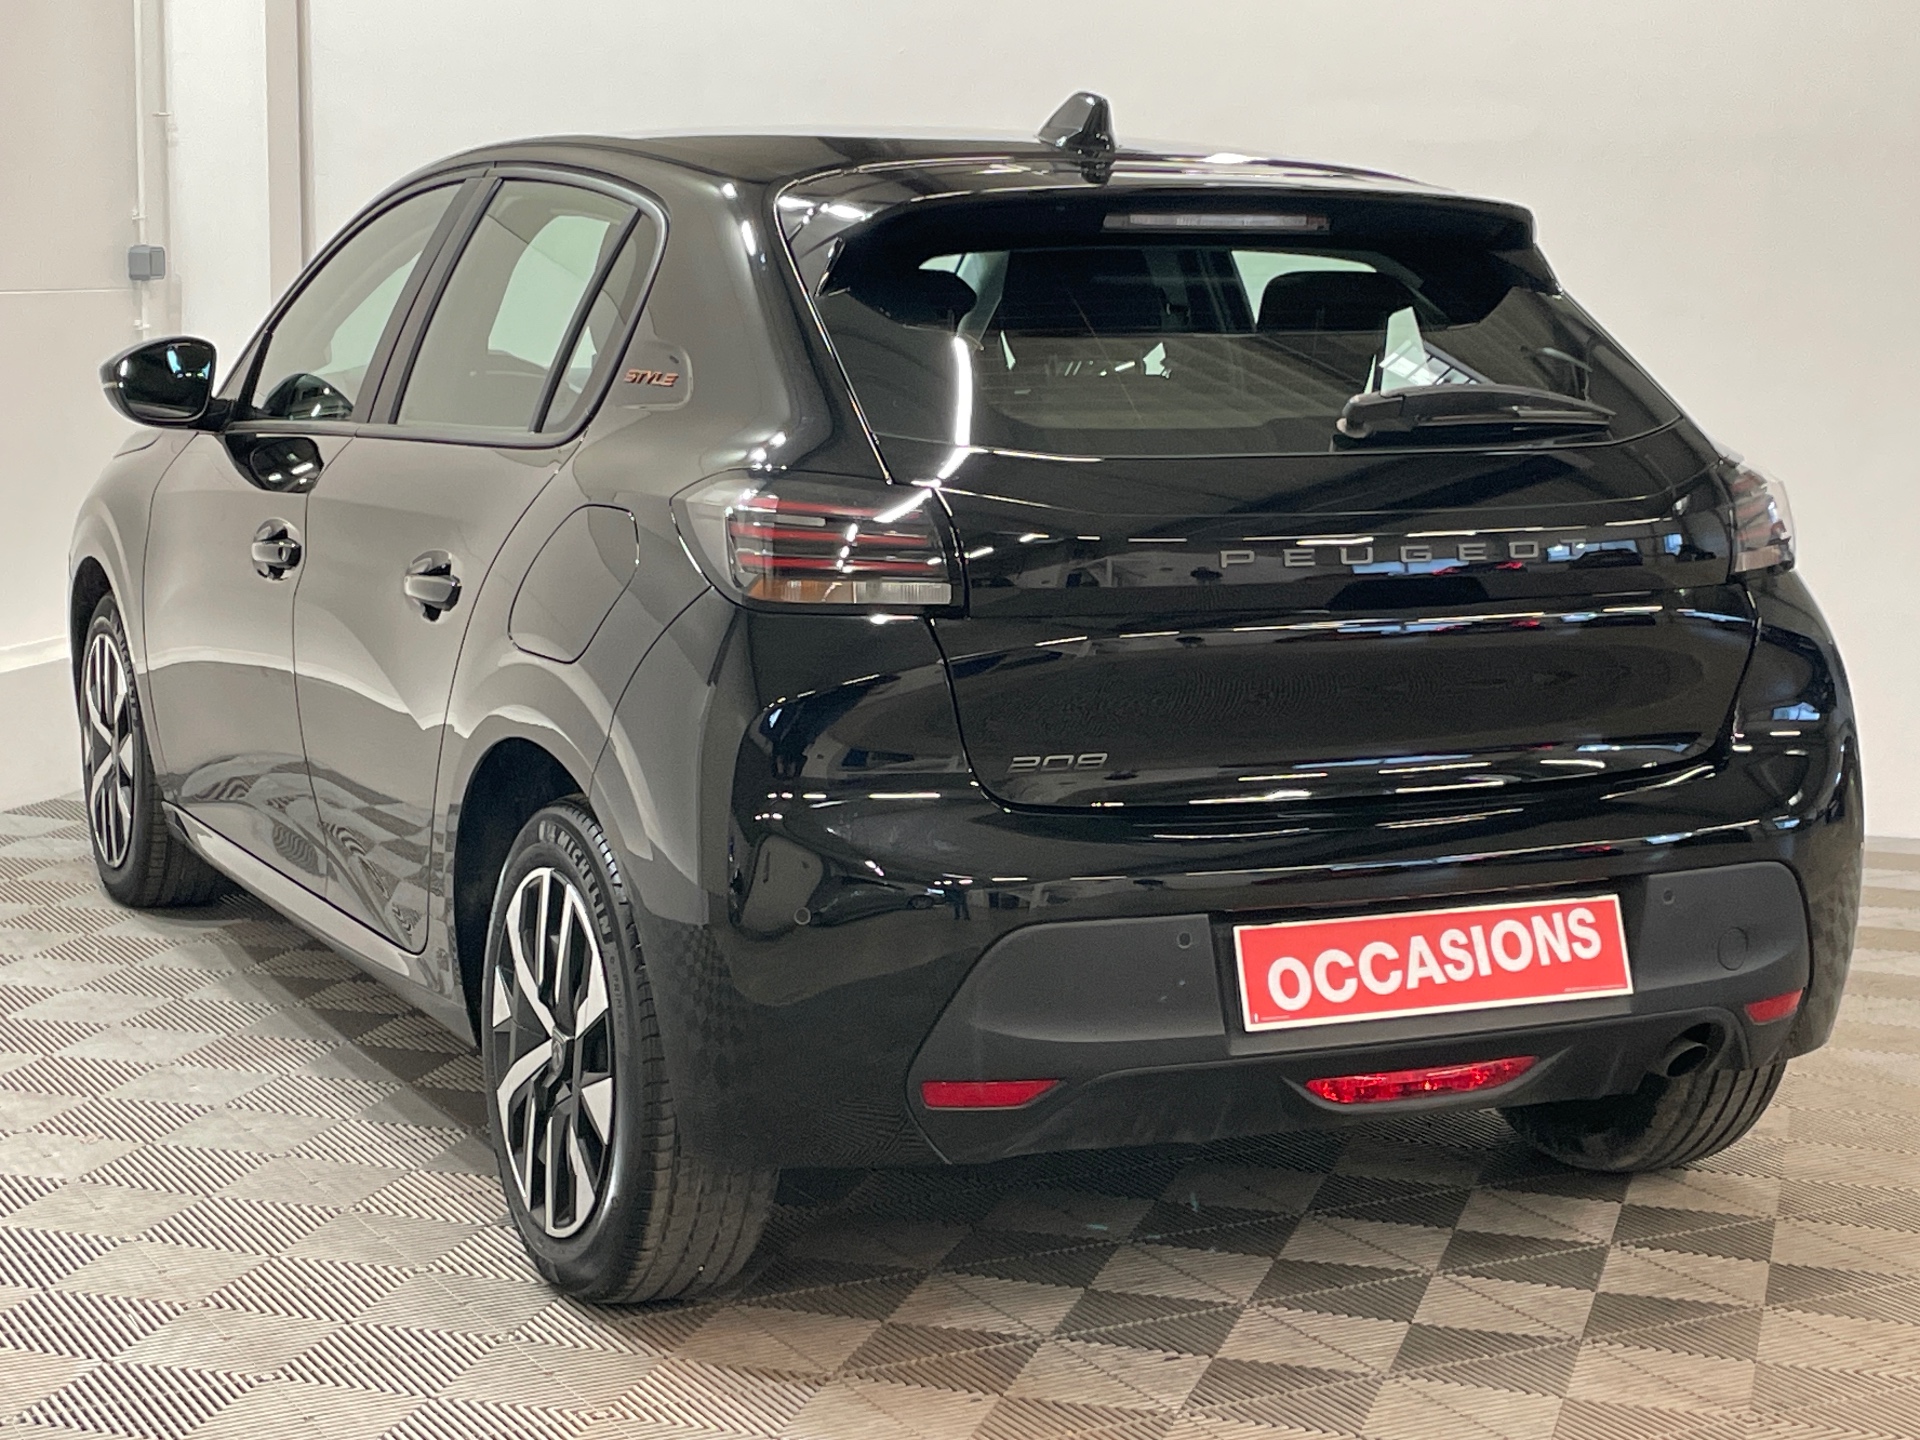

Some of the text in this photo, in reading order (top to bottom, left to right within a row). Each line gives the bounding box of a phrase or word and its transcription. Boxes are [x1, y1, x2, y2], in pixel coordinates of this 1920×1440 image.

[624, 368, 679, 387] STYLE
[1219, 538, 1588, 568] PEUGEOT
[1007, 752, 1108, 773] 208
[1267, 907, 1602, 1012] OCCASIONS
